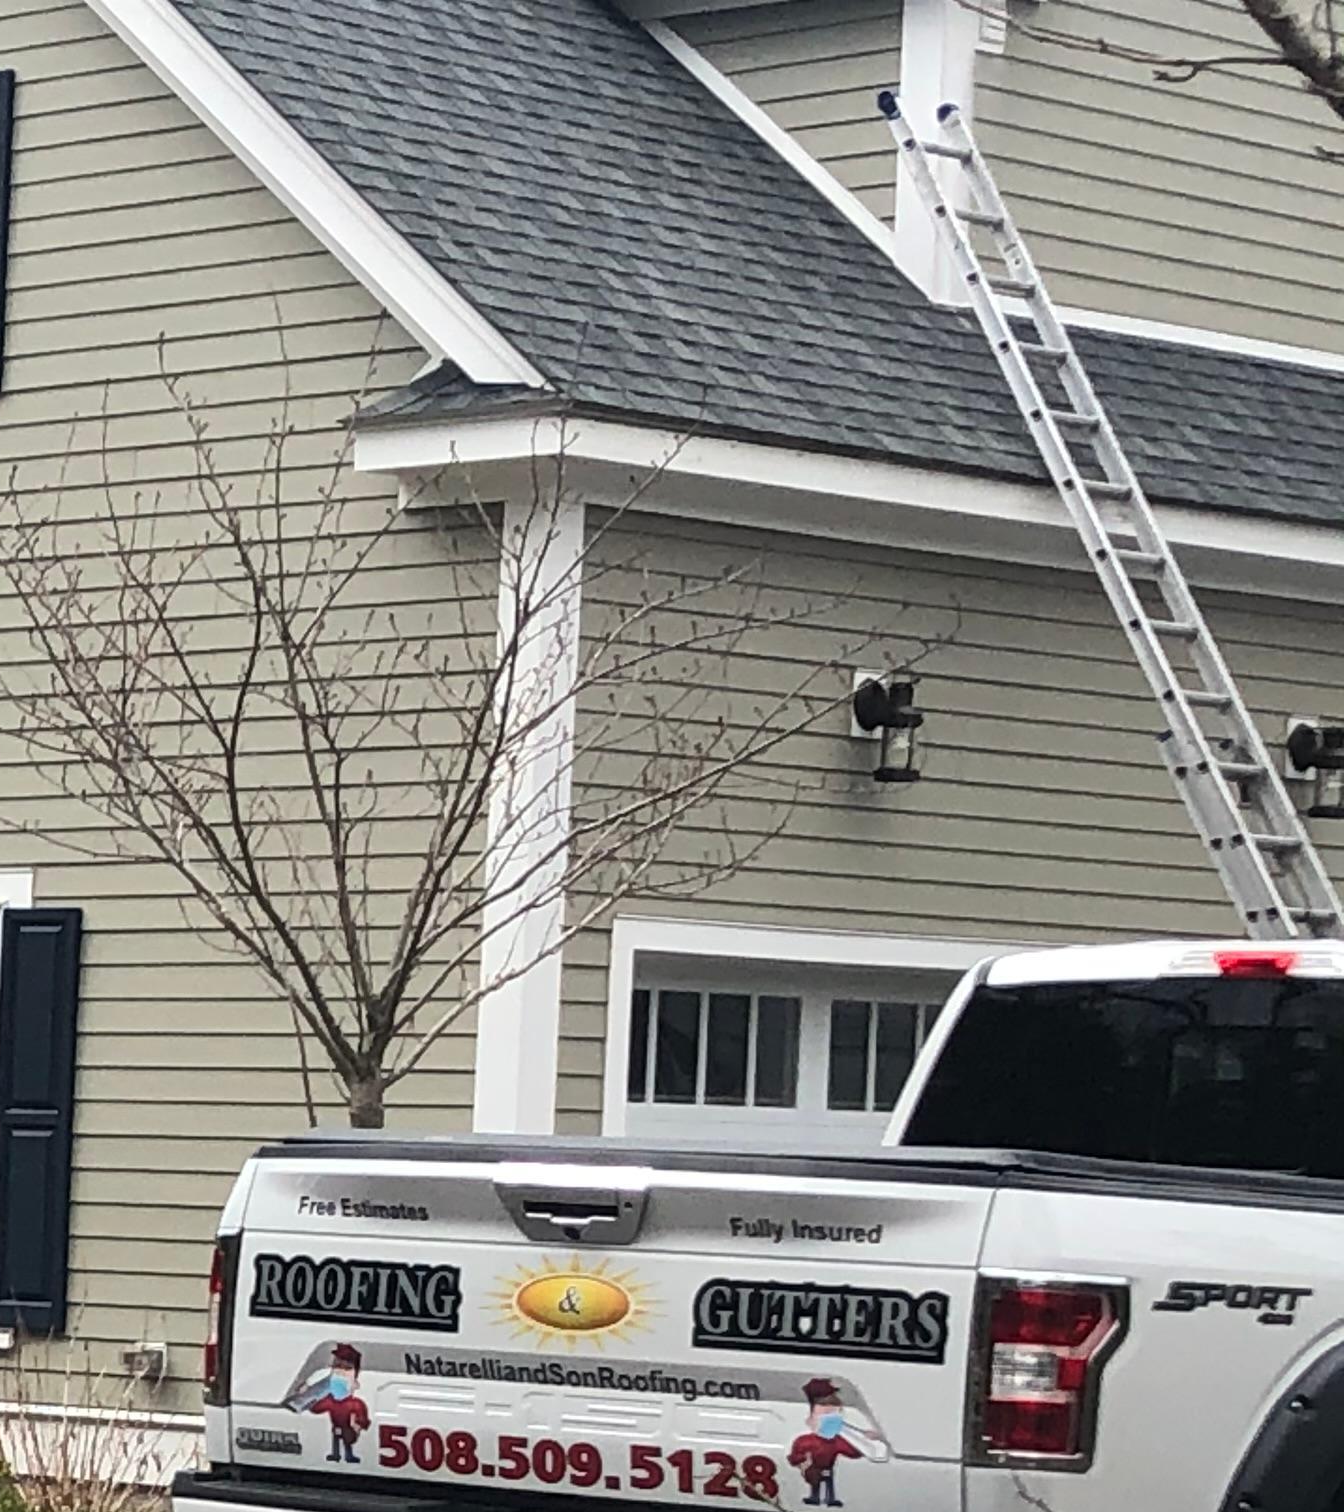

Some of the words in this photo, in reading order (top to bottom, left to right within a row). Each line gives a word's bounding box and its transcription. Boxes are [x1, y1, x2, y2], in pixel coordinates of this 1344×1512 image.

[297, 1196, 336, 1216] Free
[341, 1198, 429, 1221] Estimates
[730, 1217, 783, 1243] Fully
[792, 1220, 882, 1244] Insured
[255, 1258, 457, 1318] ROOFING
[558, 1285, 581, 1315] &
[698, 1284, 945, 1349] GUTTERS
[1151, 1280, 1314, 1312] SPORT
[404, 1352, 760, 1401] NatarelliandSonRoofing.com
[378, 1424, 780, 1500] 508.509.5128
